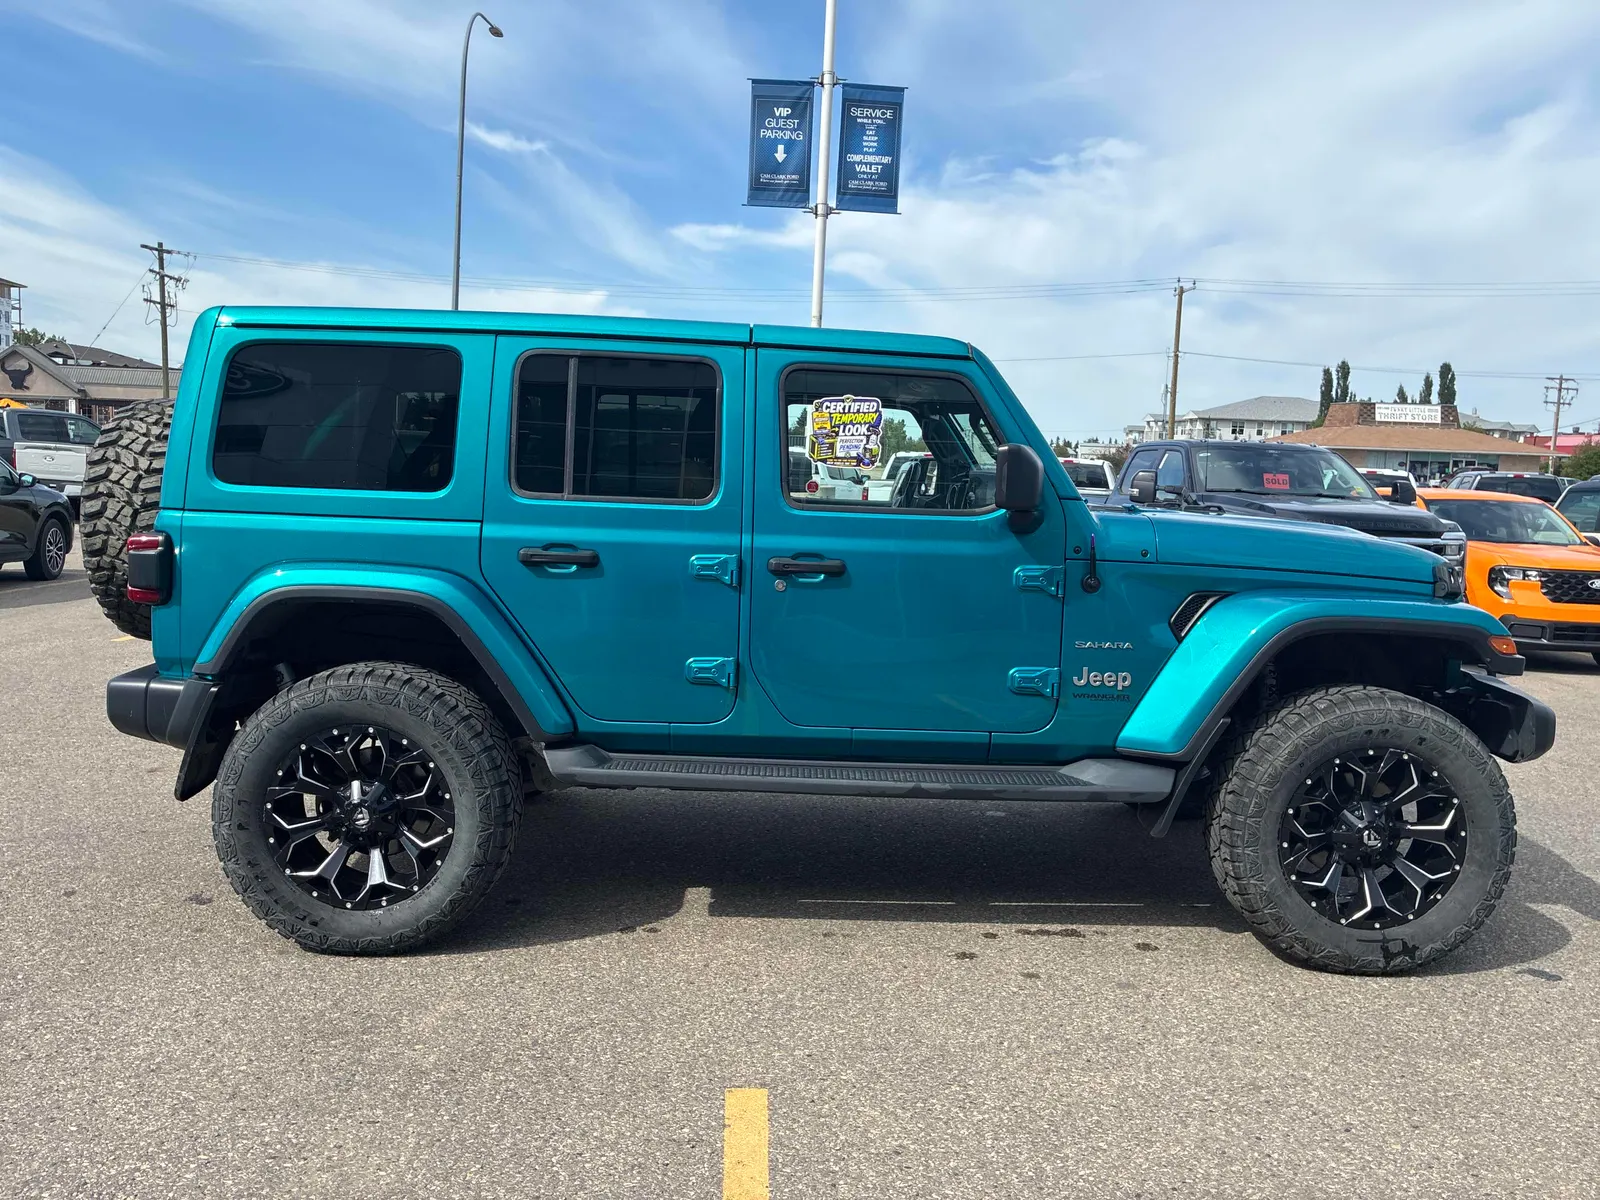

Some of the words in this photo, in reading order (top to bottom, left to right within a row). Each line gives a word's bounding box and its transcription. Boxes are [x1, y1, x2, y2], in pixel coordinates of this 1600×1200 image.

[774, 107, 792, 117] VIP
[850, 107, 894, 119] SERVICE
[765, 118, 799, 129] GUEST
[760, 129, 803, 140] PARKING
[846, 154, 893, 164] COMPLEMENTARY
[855, 164, 882, 173] VALET
[822, 401, 877, 413] CERTIFIED
[831, 413, 878, 425] TEMPORARY
[1378, 412, 1409, 420] THRIFT
[1411, 413, 1439, 421] STORE
[1265, 477, 1288, 486] SOLD
[1075, 640, 1133, 649] SAHARA
[1072, 666, 1132, 691] Jeep
